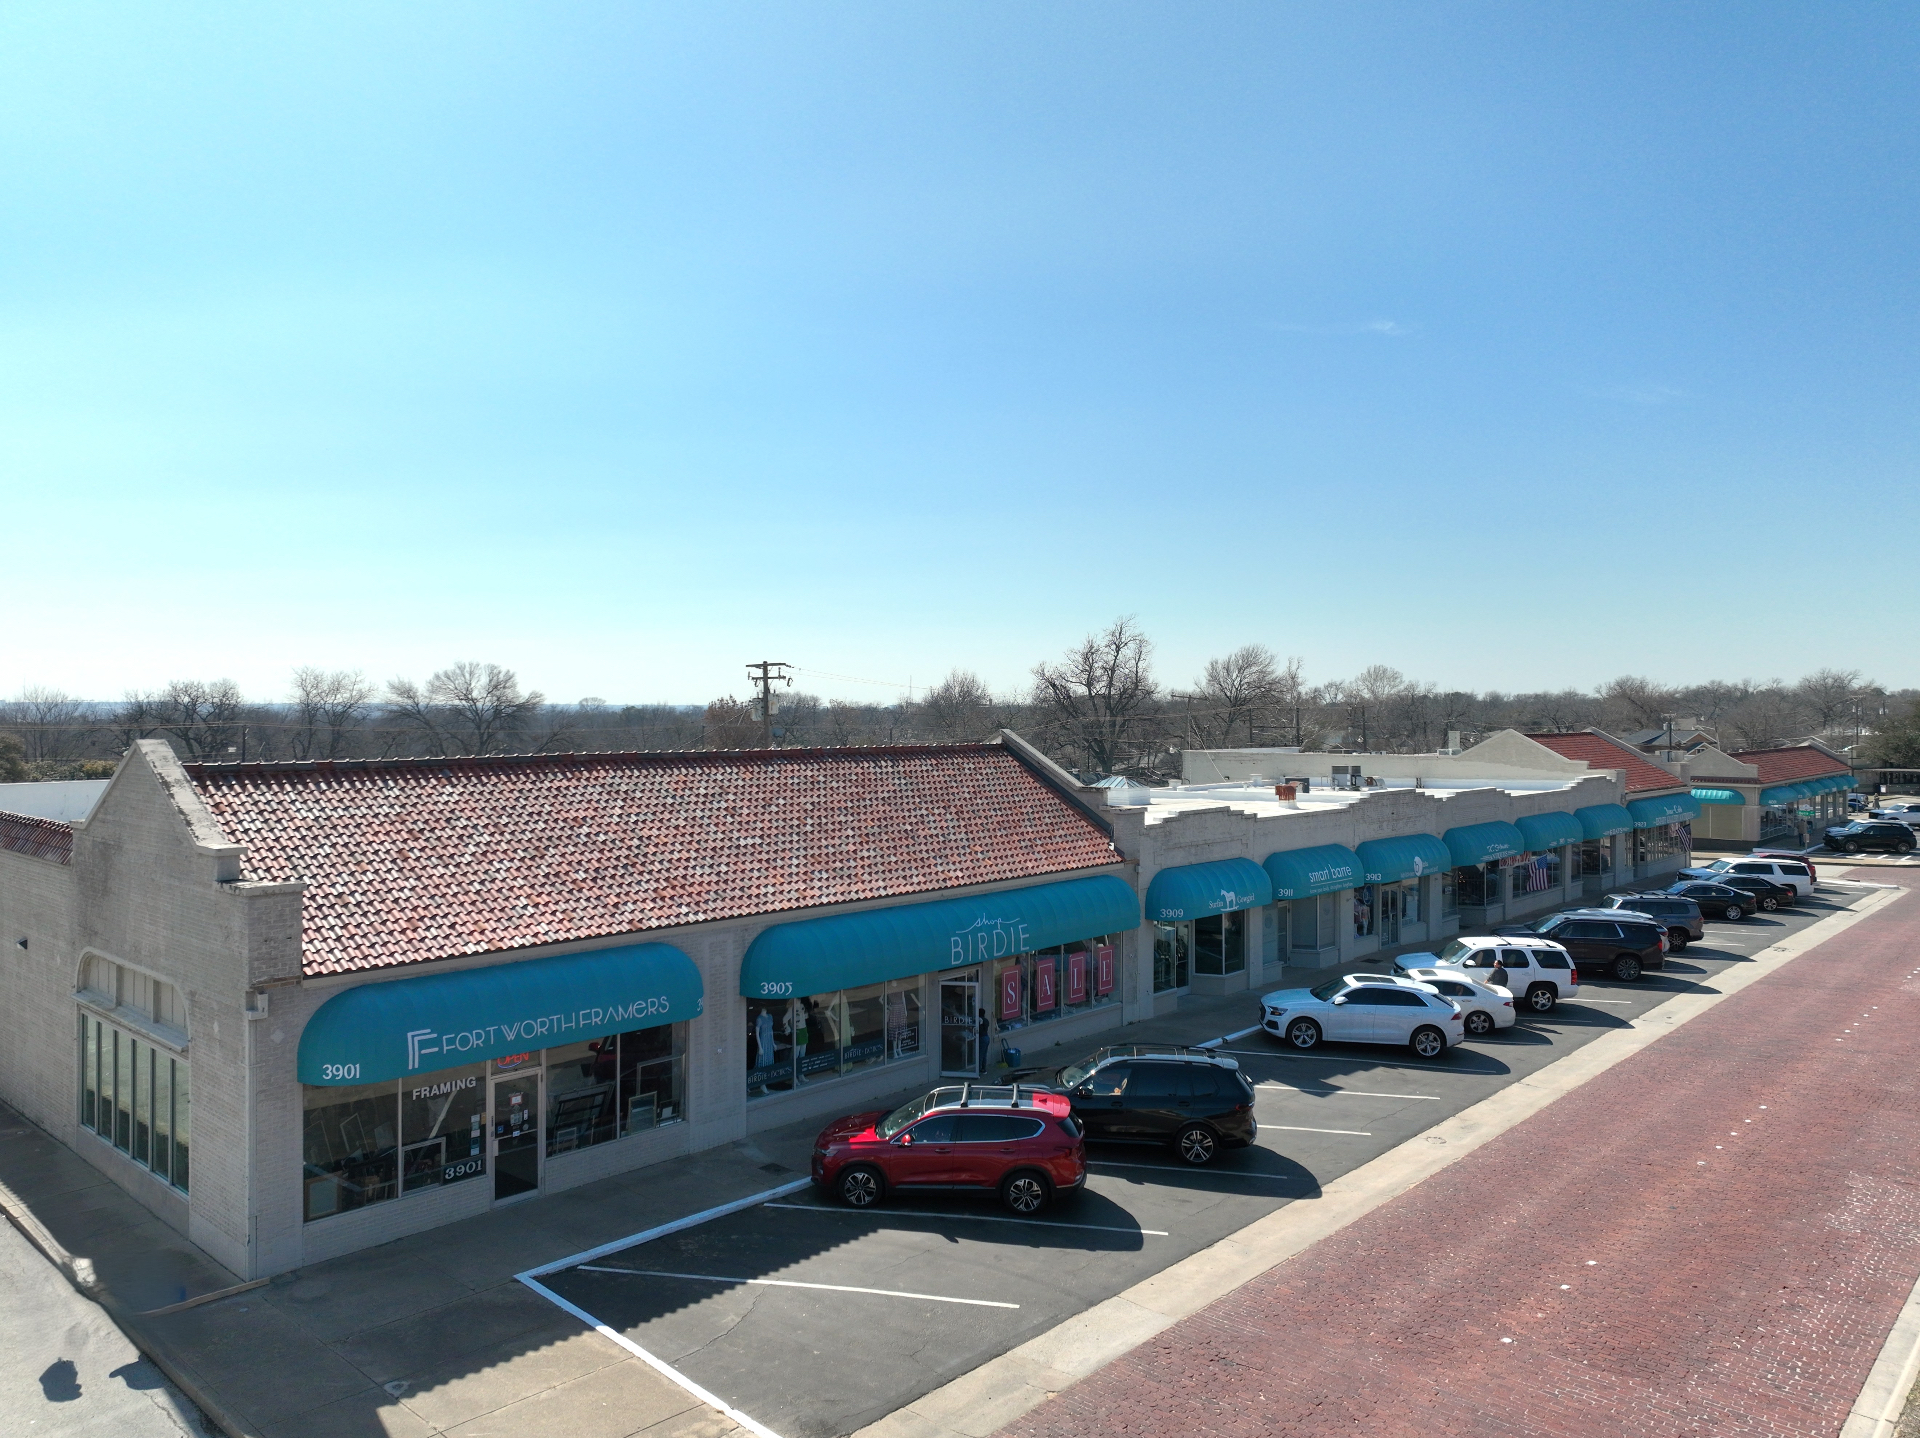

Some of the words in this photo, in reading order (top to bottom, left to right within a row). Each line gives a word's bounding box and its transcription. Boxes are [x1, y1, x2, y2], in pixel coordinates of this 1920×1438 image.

[1308, 866, 1330, 883] smart
[1328, 863, 1352, 879] barre
[1365, 873, 1382, 881] 3913
[1277, 888, 1294, 897] 3911
[955, 912, 1021, 934] shop
[1160, 909, 1184, 919] 3909
[950, 923, 1030, 965] BIRDIE
[760, 981, 793, 996] 3905
[442, 1025, 498, 1054] FORT
[500, 1012, 576, 1041] WORTH
[579, 995, 670, 1028] FRAMERS
[497, 1052, 529, 1065] OPEN
[322, 1063, 360, 1080] 3901
[412, 1076, 477, 1100] FRAMING
[445, 1159, 482, 1180] 3901
